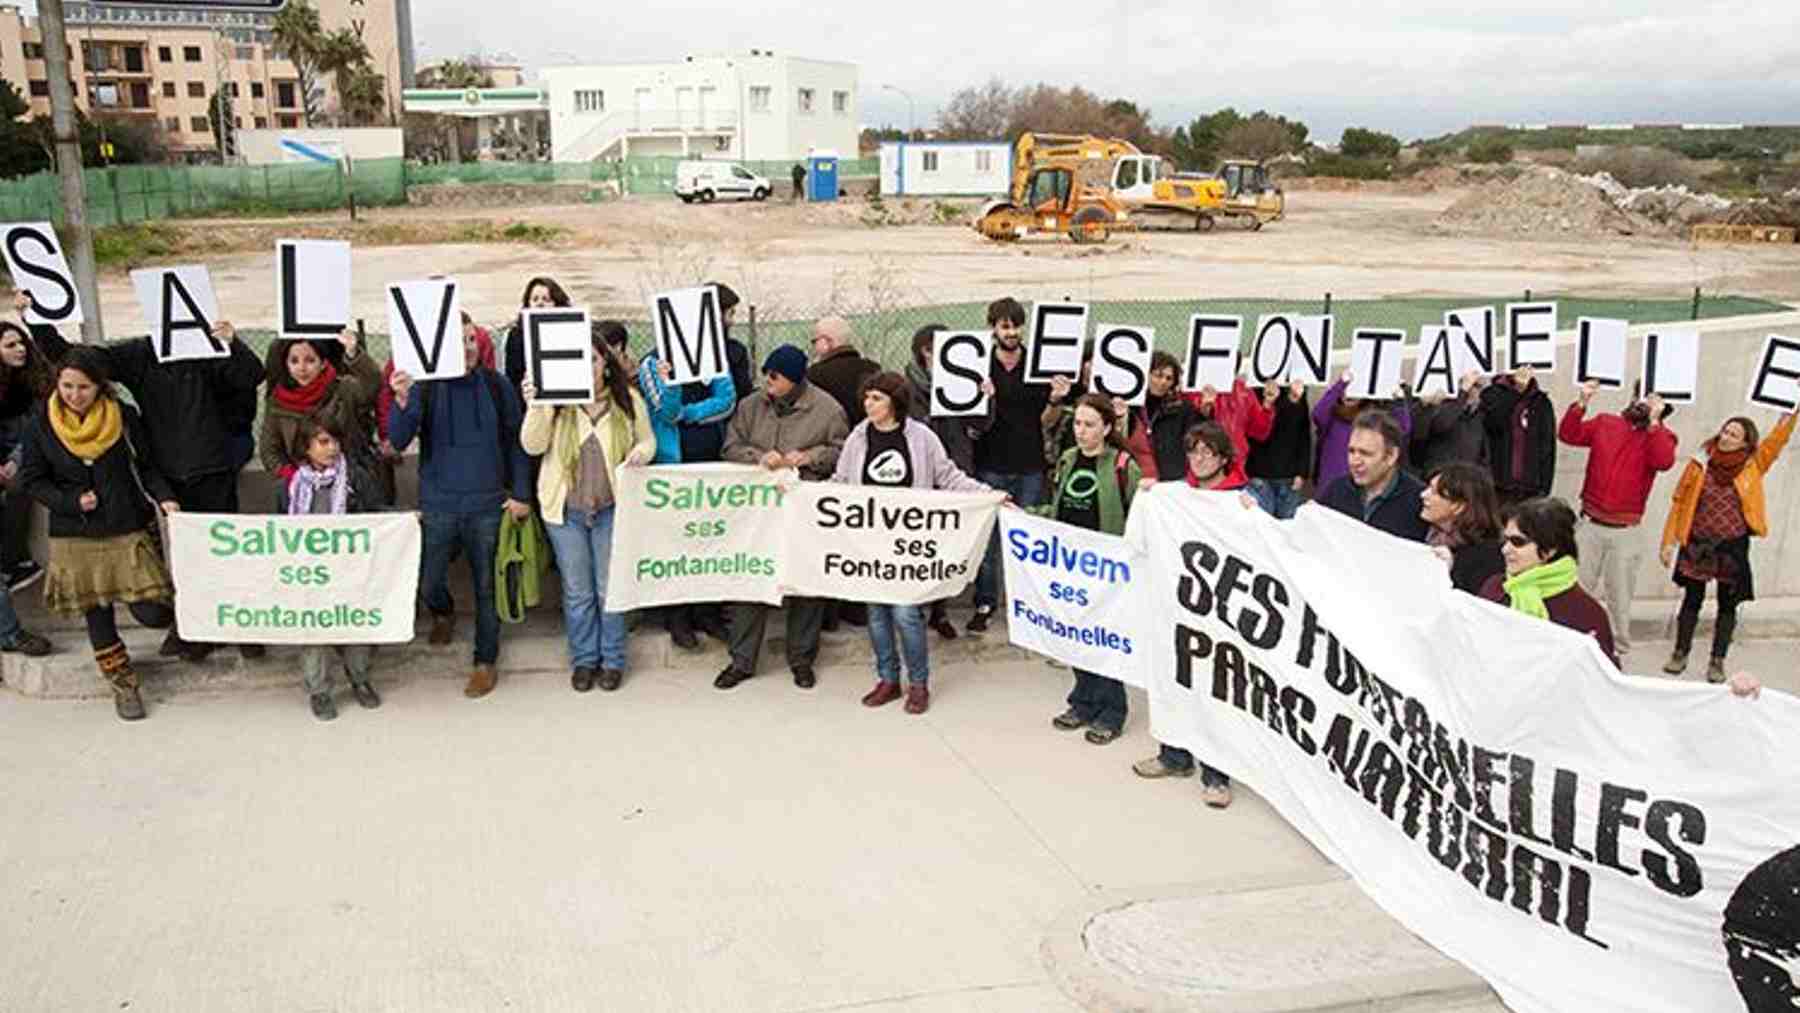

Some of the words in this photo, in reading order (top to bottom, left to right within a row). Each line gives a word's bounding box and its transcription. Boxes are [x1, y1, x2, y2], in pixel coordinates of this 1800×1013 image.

[5, 227, 75, 319] S
[160, 271, 226, 358] A
[281, 244, 346, 335] L
[390, 283, 456, 374] V
[529, 311, 590, 402] E
[657, 288, 726, 380] M
[935, 335, 985, 411] S
[1030, 305, 1084, 378] E
[1094, 329, 1148, 400] S
[1187, 318, 1239, 388] F
[1357, 331, 1402, 395] T
[1416, 329, 1454, 394] A
[1510, 307, 1552, 369] E
[1578, 321, 1620, 386] L
[1645, 335, 1692, 399] L
[1751, 338, 1800, 409] E
[645, 478, 783, 510] Salvem
[683, 519, 726, 537] ses
[816, 496, 960, 530] Salvem
[209, 520, 371, 556] Salvem
[893, 538, 937, 559] ses
[1007, 527, 1131, 583] Salvem
[280, 565, 331, 586] ses
[636, 551, 775, 579] Fontanelles
[824, 553, 968, 582] Fontanelles
[1049, 579, 1089, 607] ses
[1177, 541, 1290, 651] SES
[217, 603, 382, 628] Fontanelles
[1013, 598, 1133, 656] Fontanelles
[1175, 623, 1317, 757] PARC
[1321, 713, 1610, 951] NATURAL
